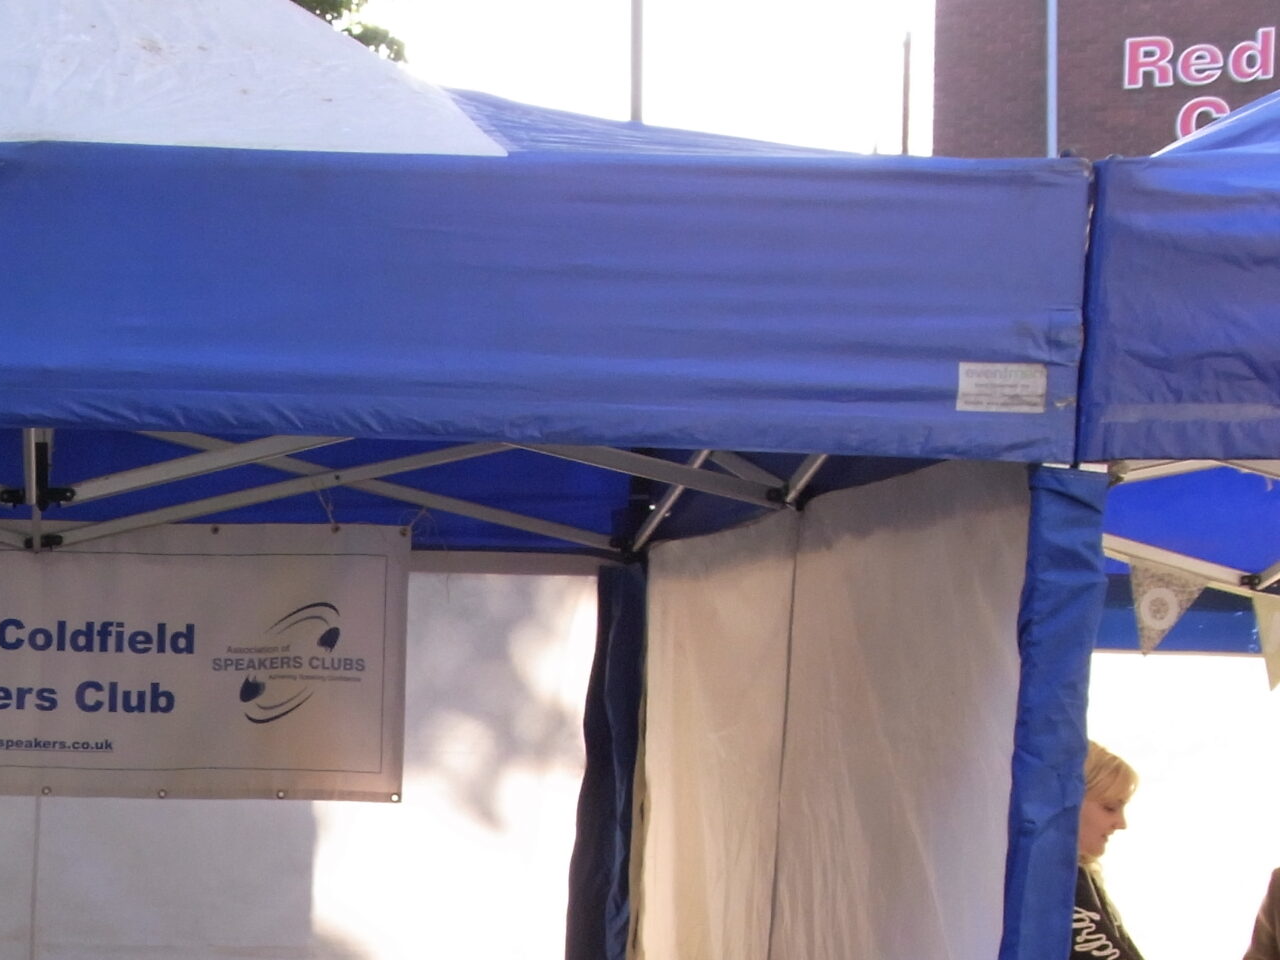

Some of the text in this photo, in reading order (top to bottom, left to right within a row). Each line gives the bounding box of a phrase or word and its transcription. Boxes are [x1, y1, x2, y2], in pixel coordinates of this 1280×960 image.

[1123, 27, 1275, 89] Red
[226, 644, 291, 655] Association of
[212, 655, 366, 672] SPEAKERS CLUBS
[75, 681, 176, 714] Club
